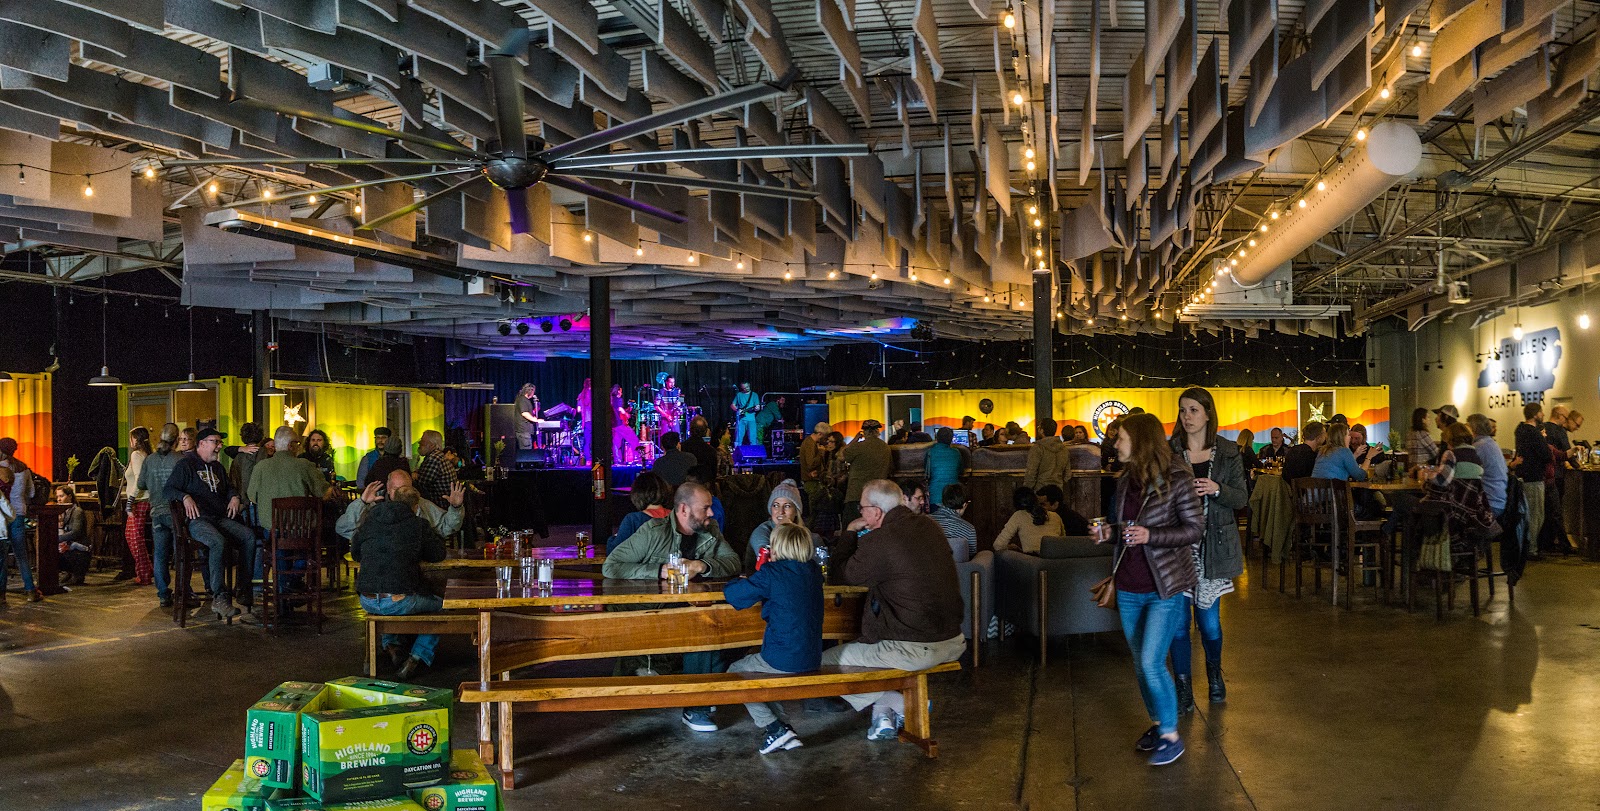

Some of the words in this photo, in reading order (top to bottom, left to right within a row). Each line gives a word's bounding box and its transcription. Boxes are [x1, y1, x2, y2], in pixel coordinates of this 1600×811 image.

[1488, 394, 1516, 409] CRAFT
[1520, 391, 1546, 407] BEER
[250, 718, 259, 749] HIGHLAND
[417, 736, 427, 744] H
[334, 742, 391, 760] HIGHLAND
[350, 752, 365, 760] SINCE
[340, 757, 386, 770] BREWING
[403, 763, 432, 774] DAYCATION
[454, 788, 488, 798] HIGHLAND
